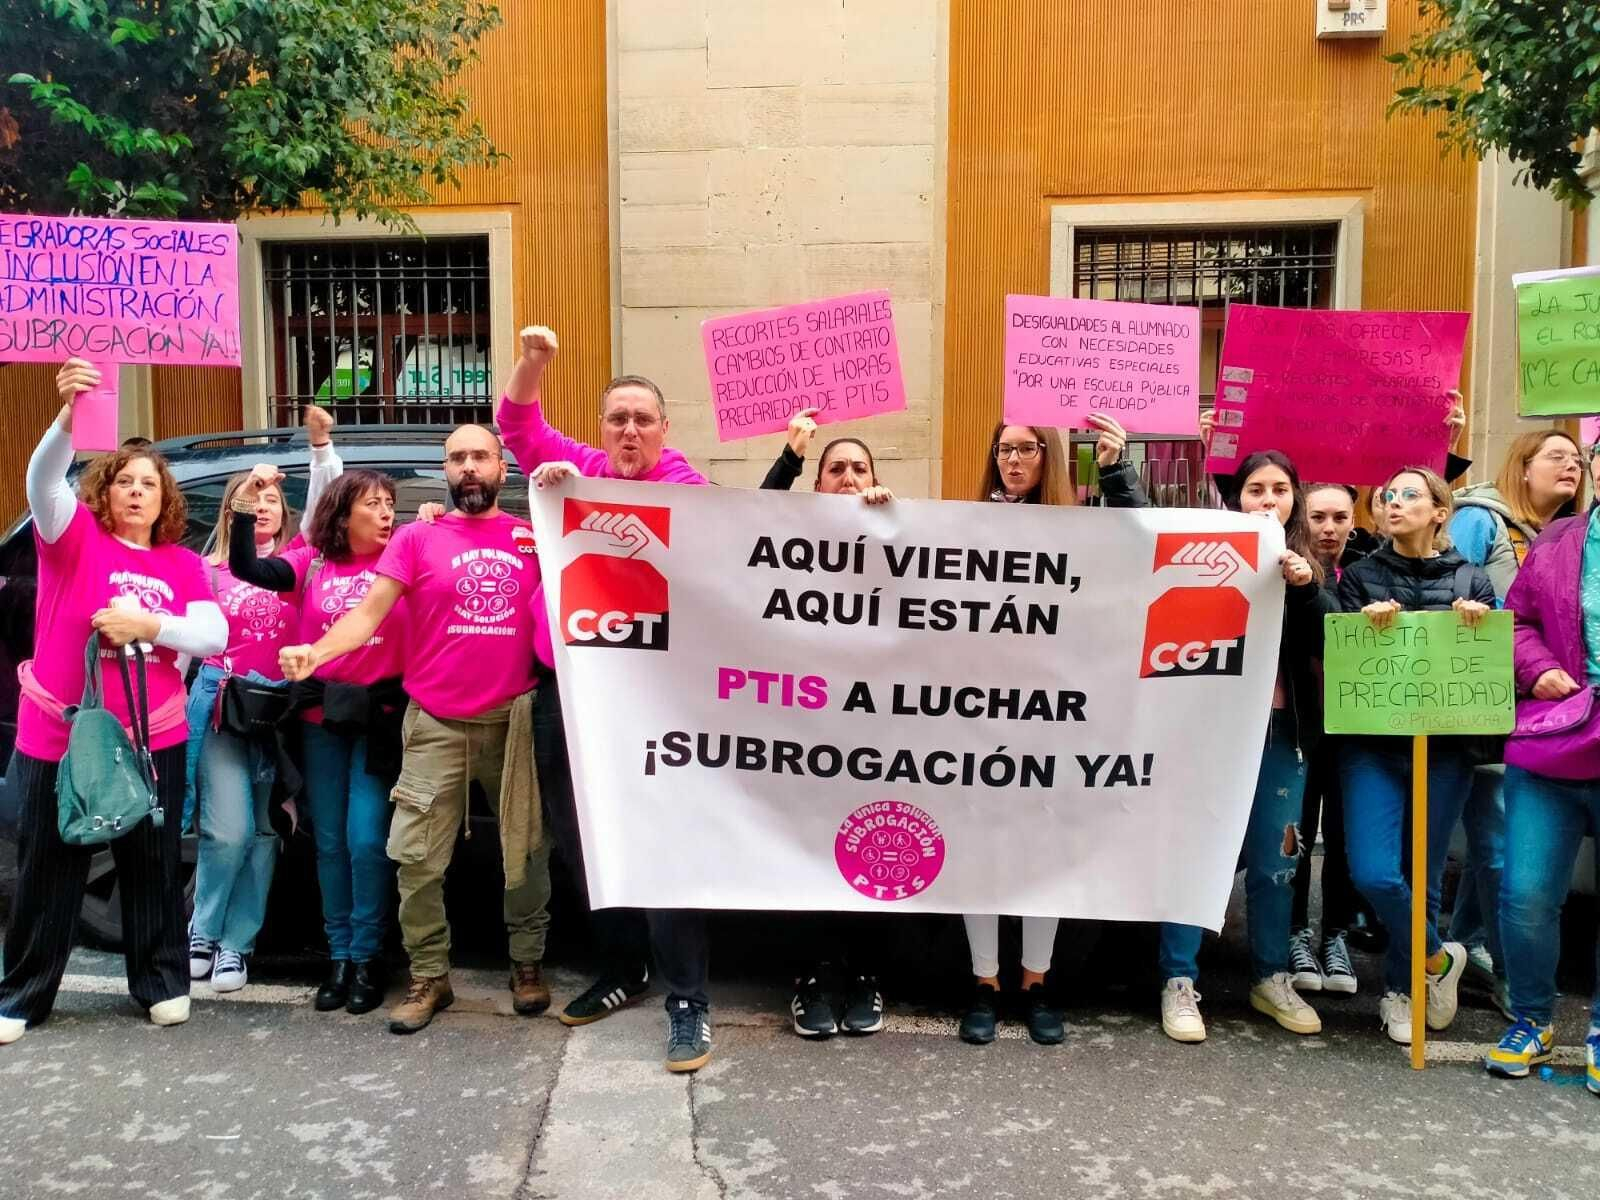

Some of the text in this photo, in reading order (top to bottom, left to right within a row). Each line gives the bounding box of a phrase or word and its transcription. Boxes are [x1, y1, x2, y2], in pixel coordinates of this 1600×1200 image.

[5, 249, 217, 286] INCLUSIÓN EN LA
[1530, 291, 1562, 317] LA
[0, 317, 185, 357] SUBROGACIÓN
[712, 299, 892, 350] RECORTES SALARIALES
[1012, 312, 1190, 339] DESIGUALDADES AL ALUMNADO
[1350, 322, 1413, 341] OFRECE
[1536, 326, 1563, 345] EL
[714, 326, 891, 376] CAMBIOS DE CONTRATO
[1041, 335, 1175, 356] CON NECESIDADES
[716, 352, 892, 404] REDUCCIÓN DE HORAS
[1018, 352, 1180, 375] EDUCATIVAS ESPECIALES
[1012, 369, 1190, 396] "POR UNA ESCUELA PÚBLICA
[718, 380, 890, 430] PRECARIEDAD DE PTIS
[1060, 393, 1156, 410] DE CALIDAD"
[747, 535, 1082, 592] AQUÍ VIENEN,
[567, 608, 662, 645] CGT
[762, 587, 1060, 635] AQUÍ ESTÁN
[1455, 624, 1492, 644] EL
[1150, 639, 1238, 671] CGT
[1358, 654, 1486, 676] COÑO DE
[718, 667, 1088, 722] PTIS A LUCHAR
[644, 730, 1154, 788] ¡SUBROGACIÓN YA!
